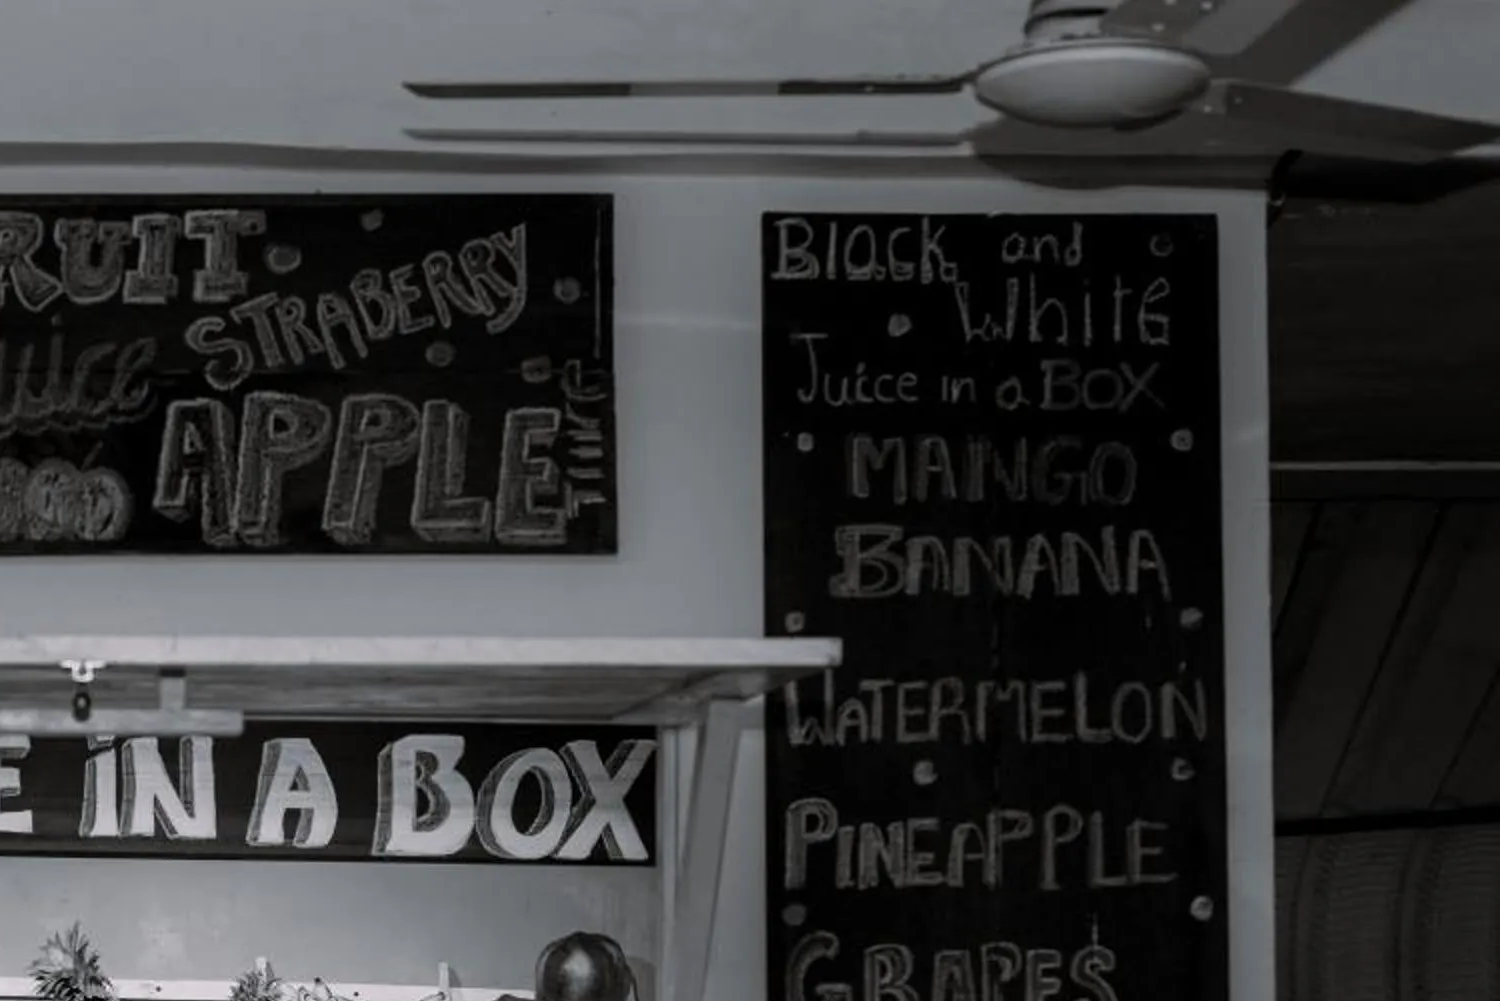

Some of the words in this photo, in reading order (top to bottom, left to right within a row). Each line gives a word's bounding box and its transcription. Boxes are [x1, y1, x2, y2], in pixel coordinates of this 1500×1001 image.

[1000, 220, 1084, 268] and
[789, 332, 921, 408] Juice
[940, 373, 979, 404] in
[151, 389, 567, 547] APPLE
[845, 432, 1140, 505] MANGO
[828, 523, 1172, 602] BANANA
[246, 737, 338, 847] A
[371, 733, 656, 861] BOX
[784, 797, 1180, 891] PINEAPPLE
